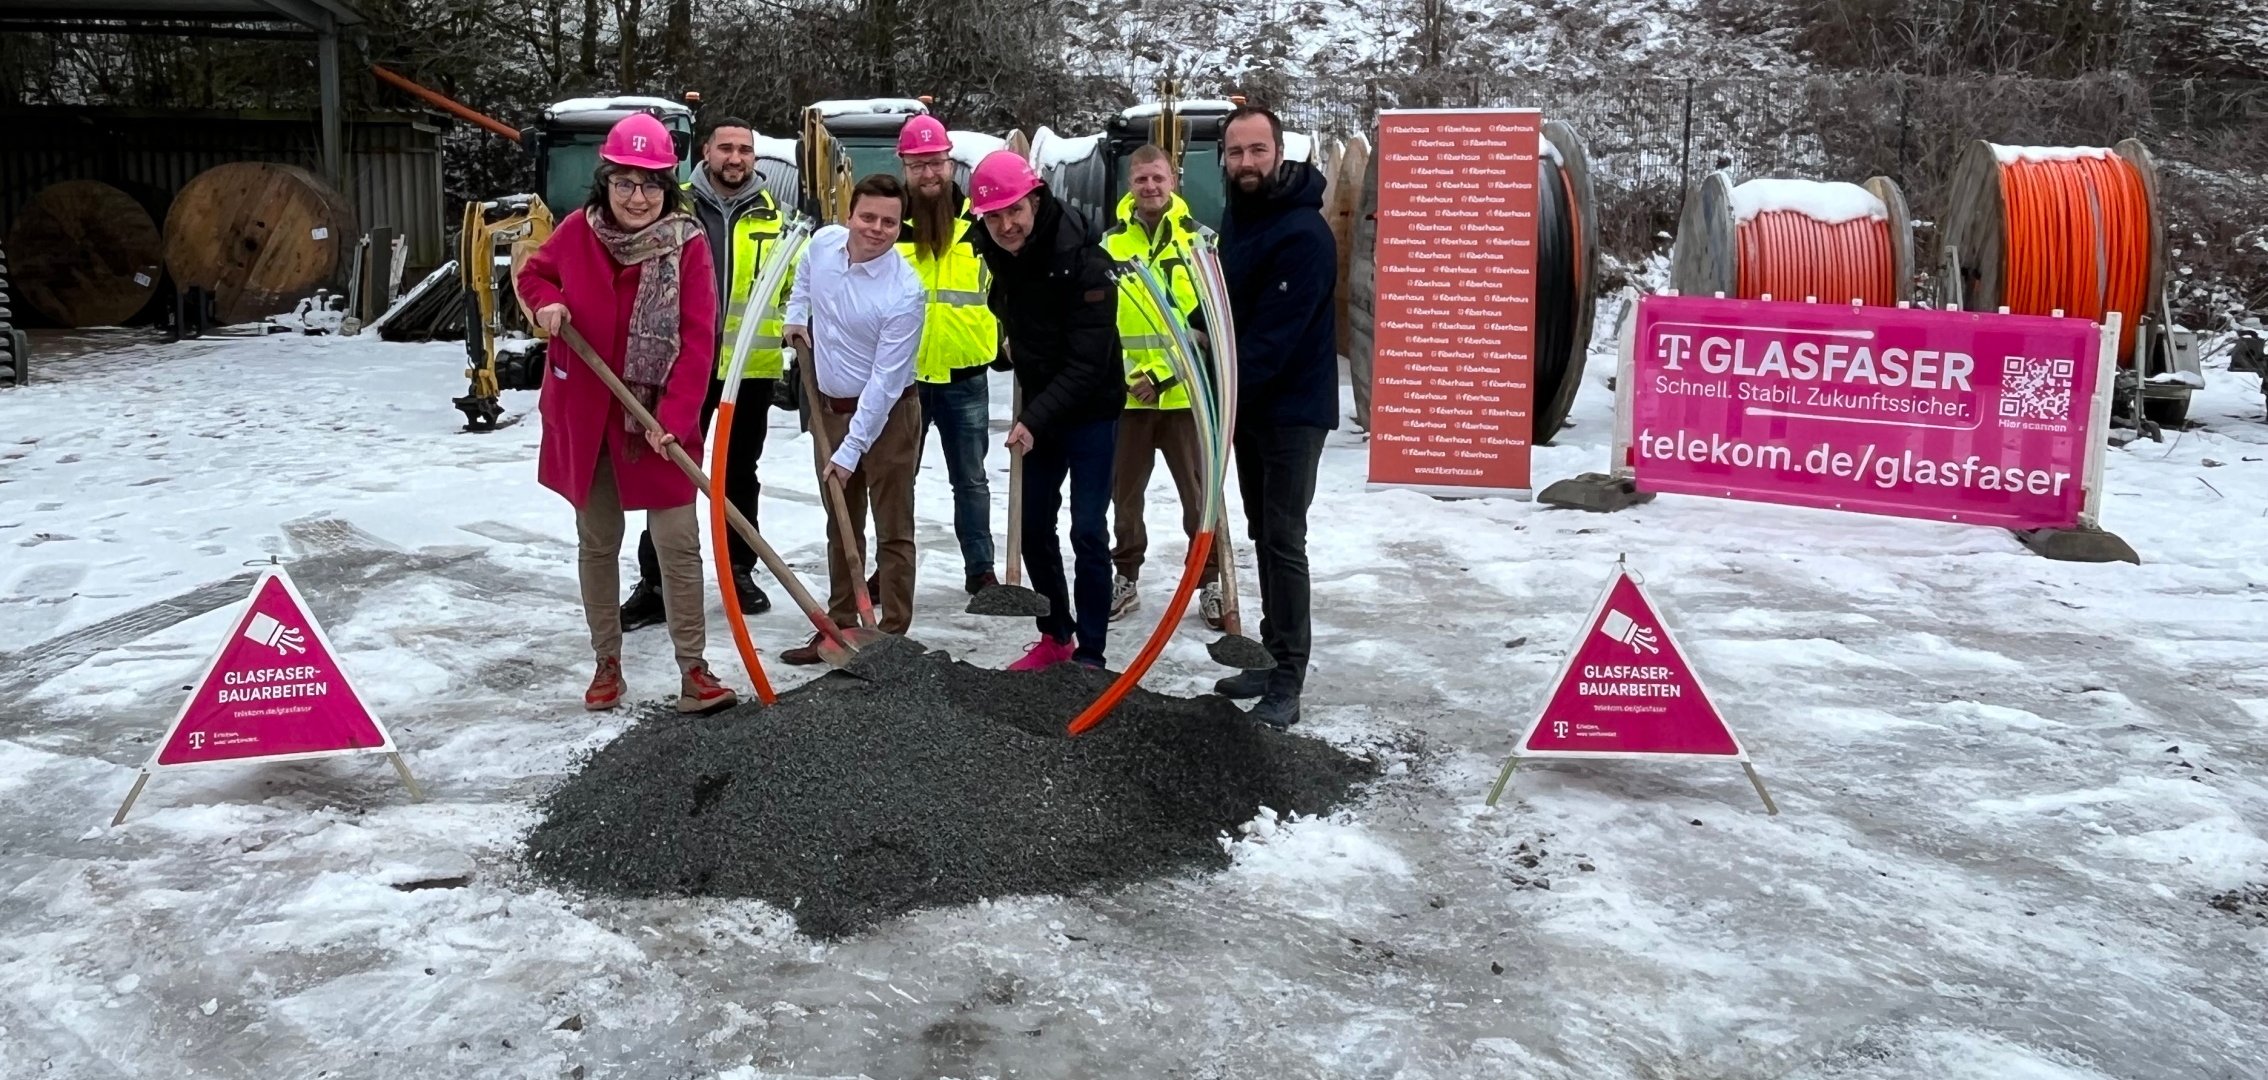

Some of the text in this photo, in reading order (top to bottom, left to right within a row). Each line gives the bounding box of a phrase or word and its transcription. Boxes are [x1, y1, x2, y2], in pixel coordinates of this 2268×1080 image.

[1469, 167, 1506, 175] fiberhaus
[1495, 181, 1532, 189] fiberhaus
[1416, 195, 1505, 203] fiberhaus fiberhaus
[1442, 209, 1478, 217] fiberhaus
[1493, 209, 1531, 217] fiberhaus
[1416, 223, 1452, 231] fiberhaus
[1493, 238, 1530, 246] fiberhaus
[1415, 251, 1451, 259] fiberhaus
[1466, 280, 1502, 288] fiberhaus
[1388, 293, 1424, 301] fiberhaus
[1491, 295, 1529, 303] fiberhaus
[1465, 308, 1502, 316] fiberhaus
[1387, 321, 1528, 331] fiberhaus fiberhaus fiberhaus
[1386, 349, 1423, 357] fiberhaus
[1412, 364, 1500, 373] fiberhaus fiberhaus
[1700, 336, 1975, 392] GLASFASER
[1437, 378, 1474, 386] fiberhaus
[1489, 380, 1526, 388] fiberhaus
[1410, 392, 1500, 402] fiberhaus fiberhaus
[1655, 375, 1970, 417] Schnell. Stabil. Zukunftssicher.
[1385, 405, 1525, 417] fiberhaus fiberhaus fiberhaus
[1410, 420, 1499, 430] fiberhaus fiberhaus
[1998, 419, 2067, 432] Hier scannen
[1384, 434, 1525, 445] fiberhaus fiberhaus fiberhaus
[1409, 449, 1498, 459] fiberhaus fiberhaus
[1638, 428, 2071, 498] telekom.de/glasfaser
[224, 666, 321, 686] GLASFASER-
[1584, 665, 1674, 680] GLASFASER-
[218, 682, 327, 704] BAUARBEITEN
[1579, 682, 1681, 698] BAUARBEITEN
